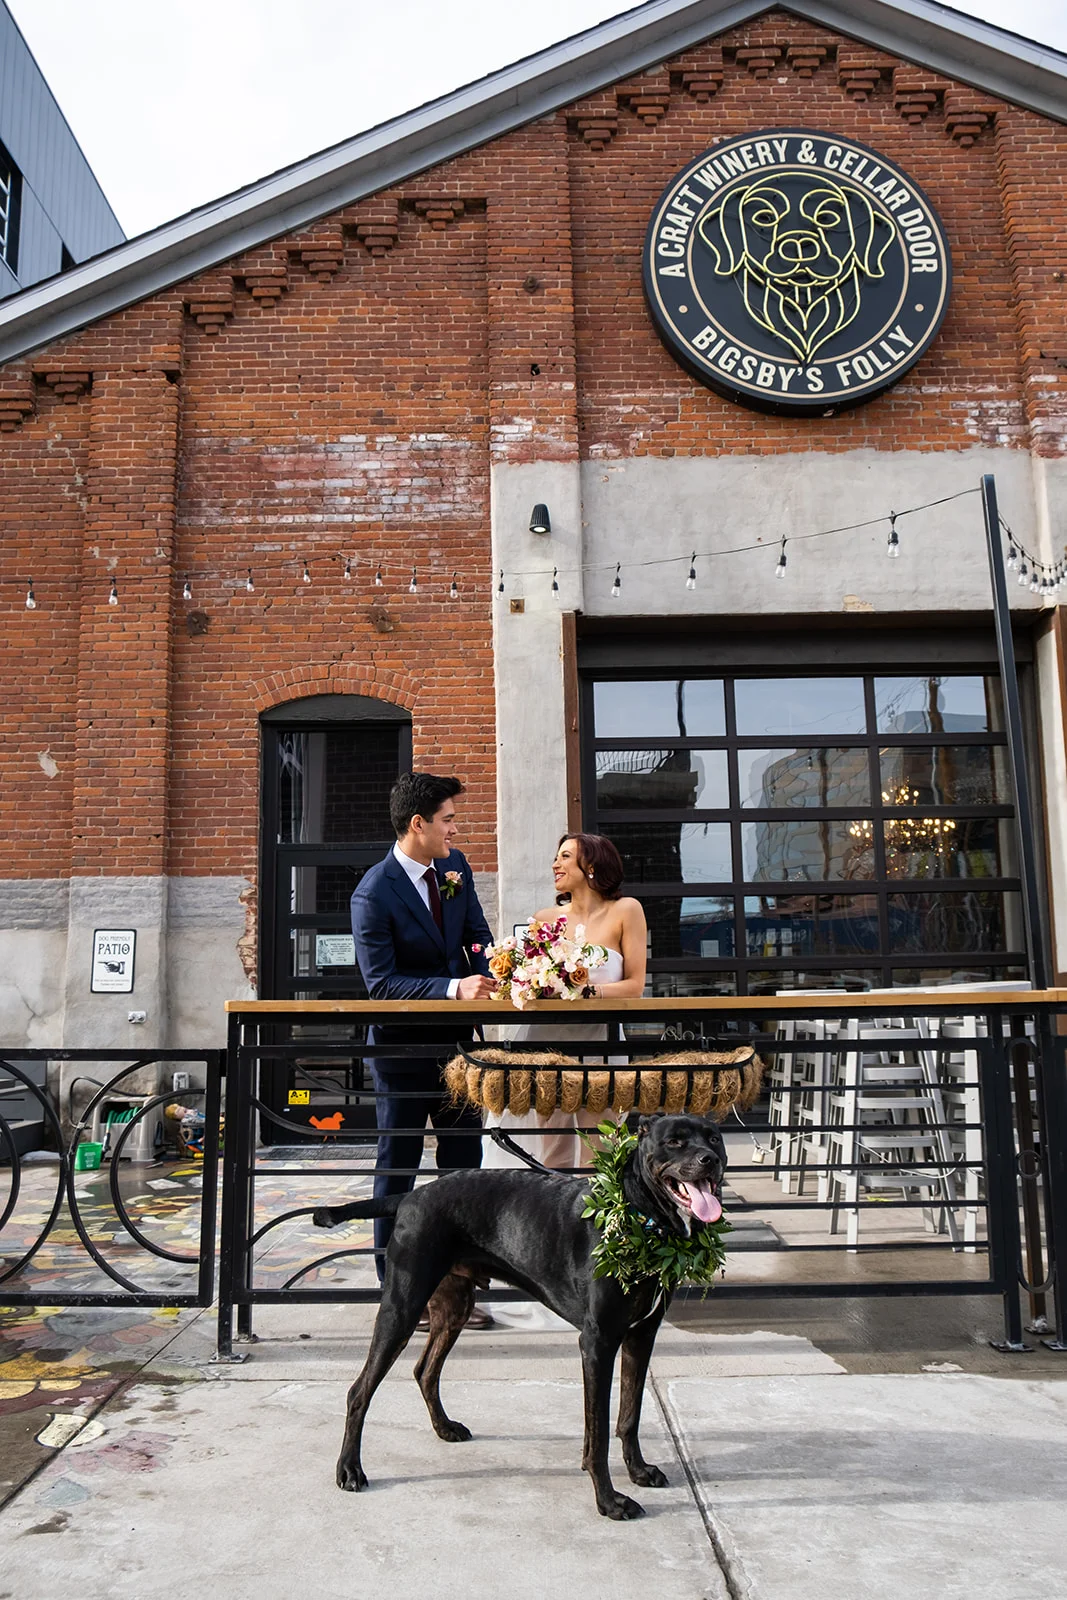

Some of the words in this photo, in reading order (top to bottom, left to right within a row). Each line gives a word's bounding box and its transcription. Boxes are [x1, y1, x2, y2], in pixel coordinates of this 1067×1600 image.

[693, 139, 789, 192] WINERY
[797, 139, 817, 164] &
[823, 145, 911, 212] CELLAR
[657, 185, 704, 258] CRAFT
[896, 207, 939, 273] DOOR
[658, 262, 686, 278] A
[691, 325, 824, 392] BIGSBY'S
[836, 325, 914, 387] FOLLY
[98, 943, 130, 955] PATIO
